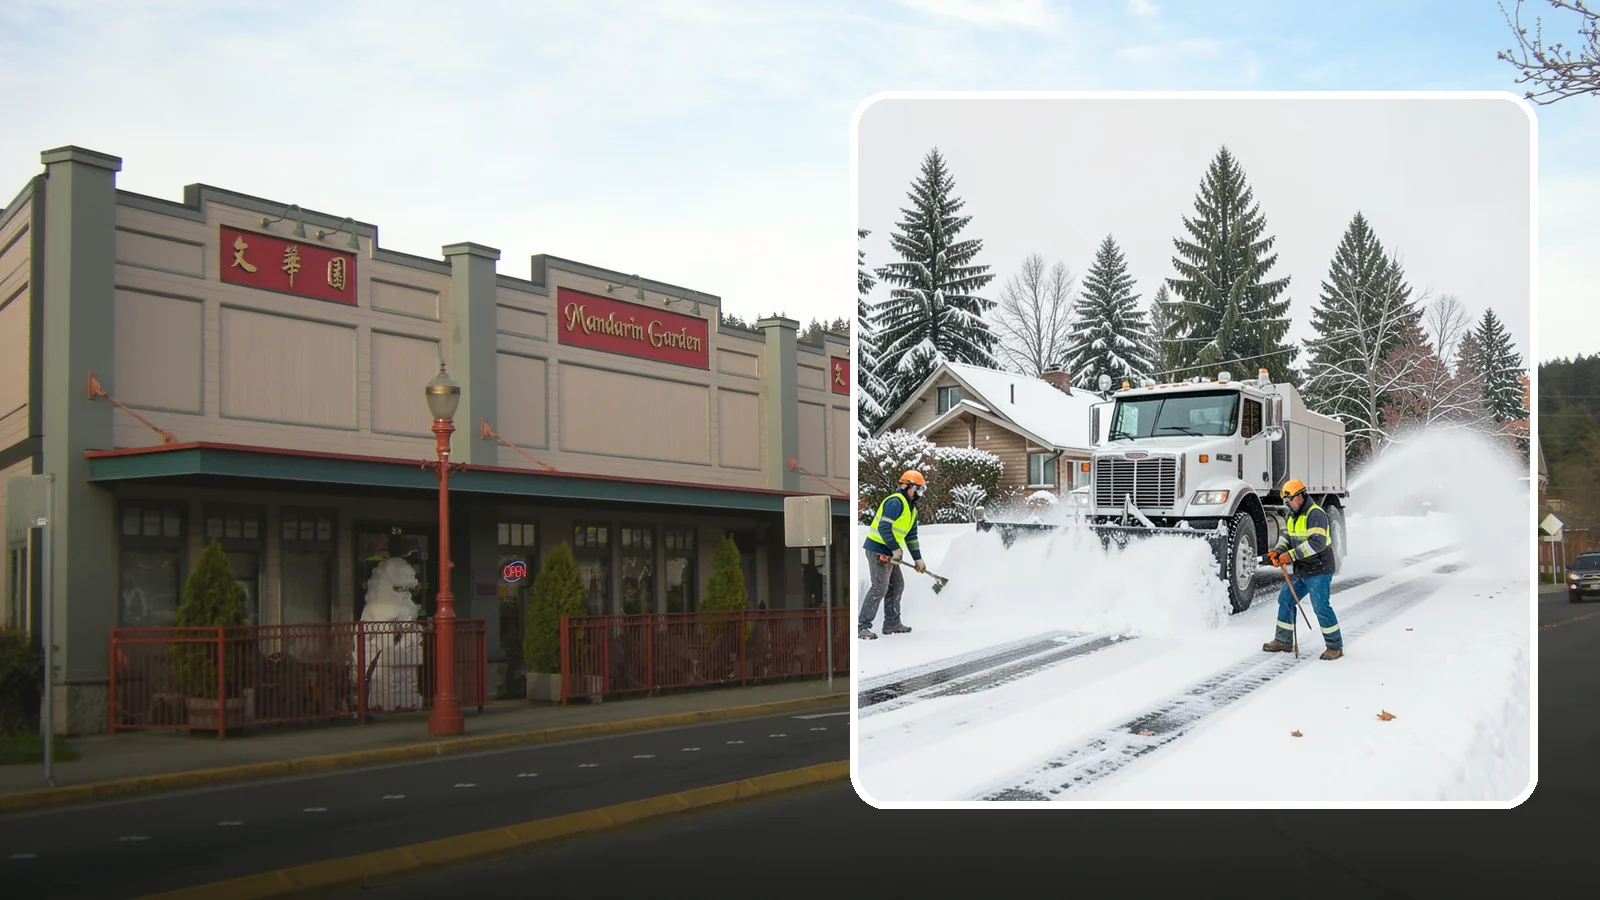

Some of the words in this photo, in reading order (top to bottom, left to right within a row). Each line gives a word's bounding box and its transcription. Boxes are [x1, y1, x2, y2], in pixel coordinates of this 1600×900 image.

[231, 236, 346, 291] 文華園
[564, 302, 644, 341] Mandarin
[648, 320, 701, 352] Garden
[503, 565, 527, 578] OPEN
